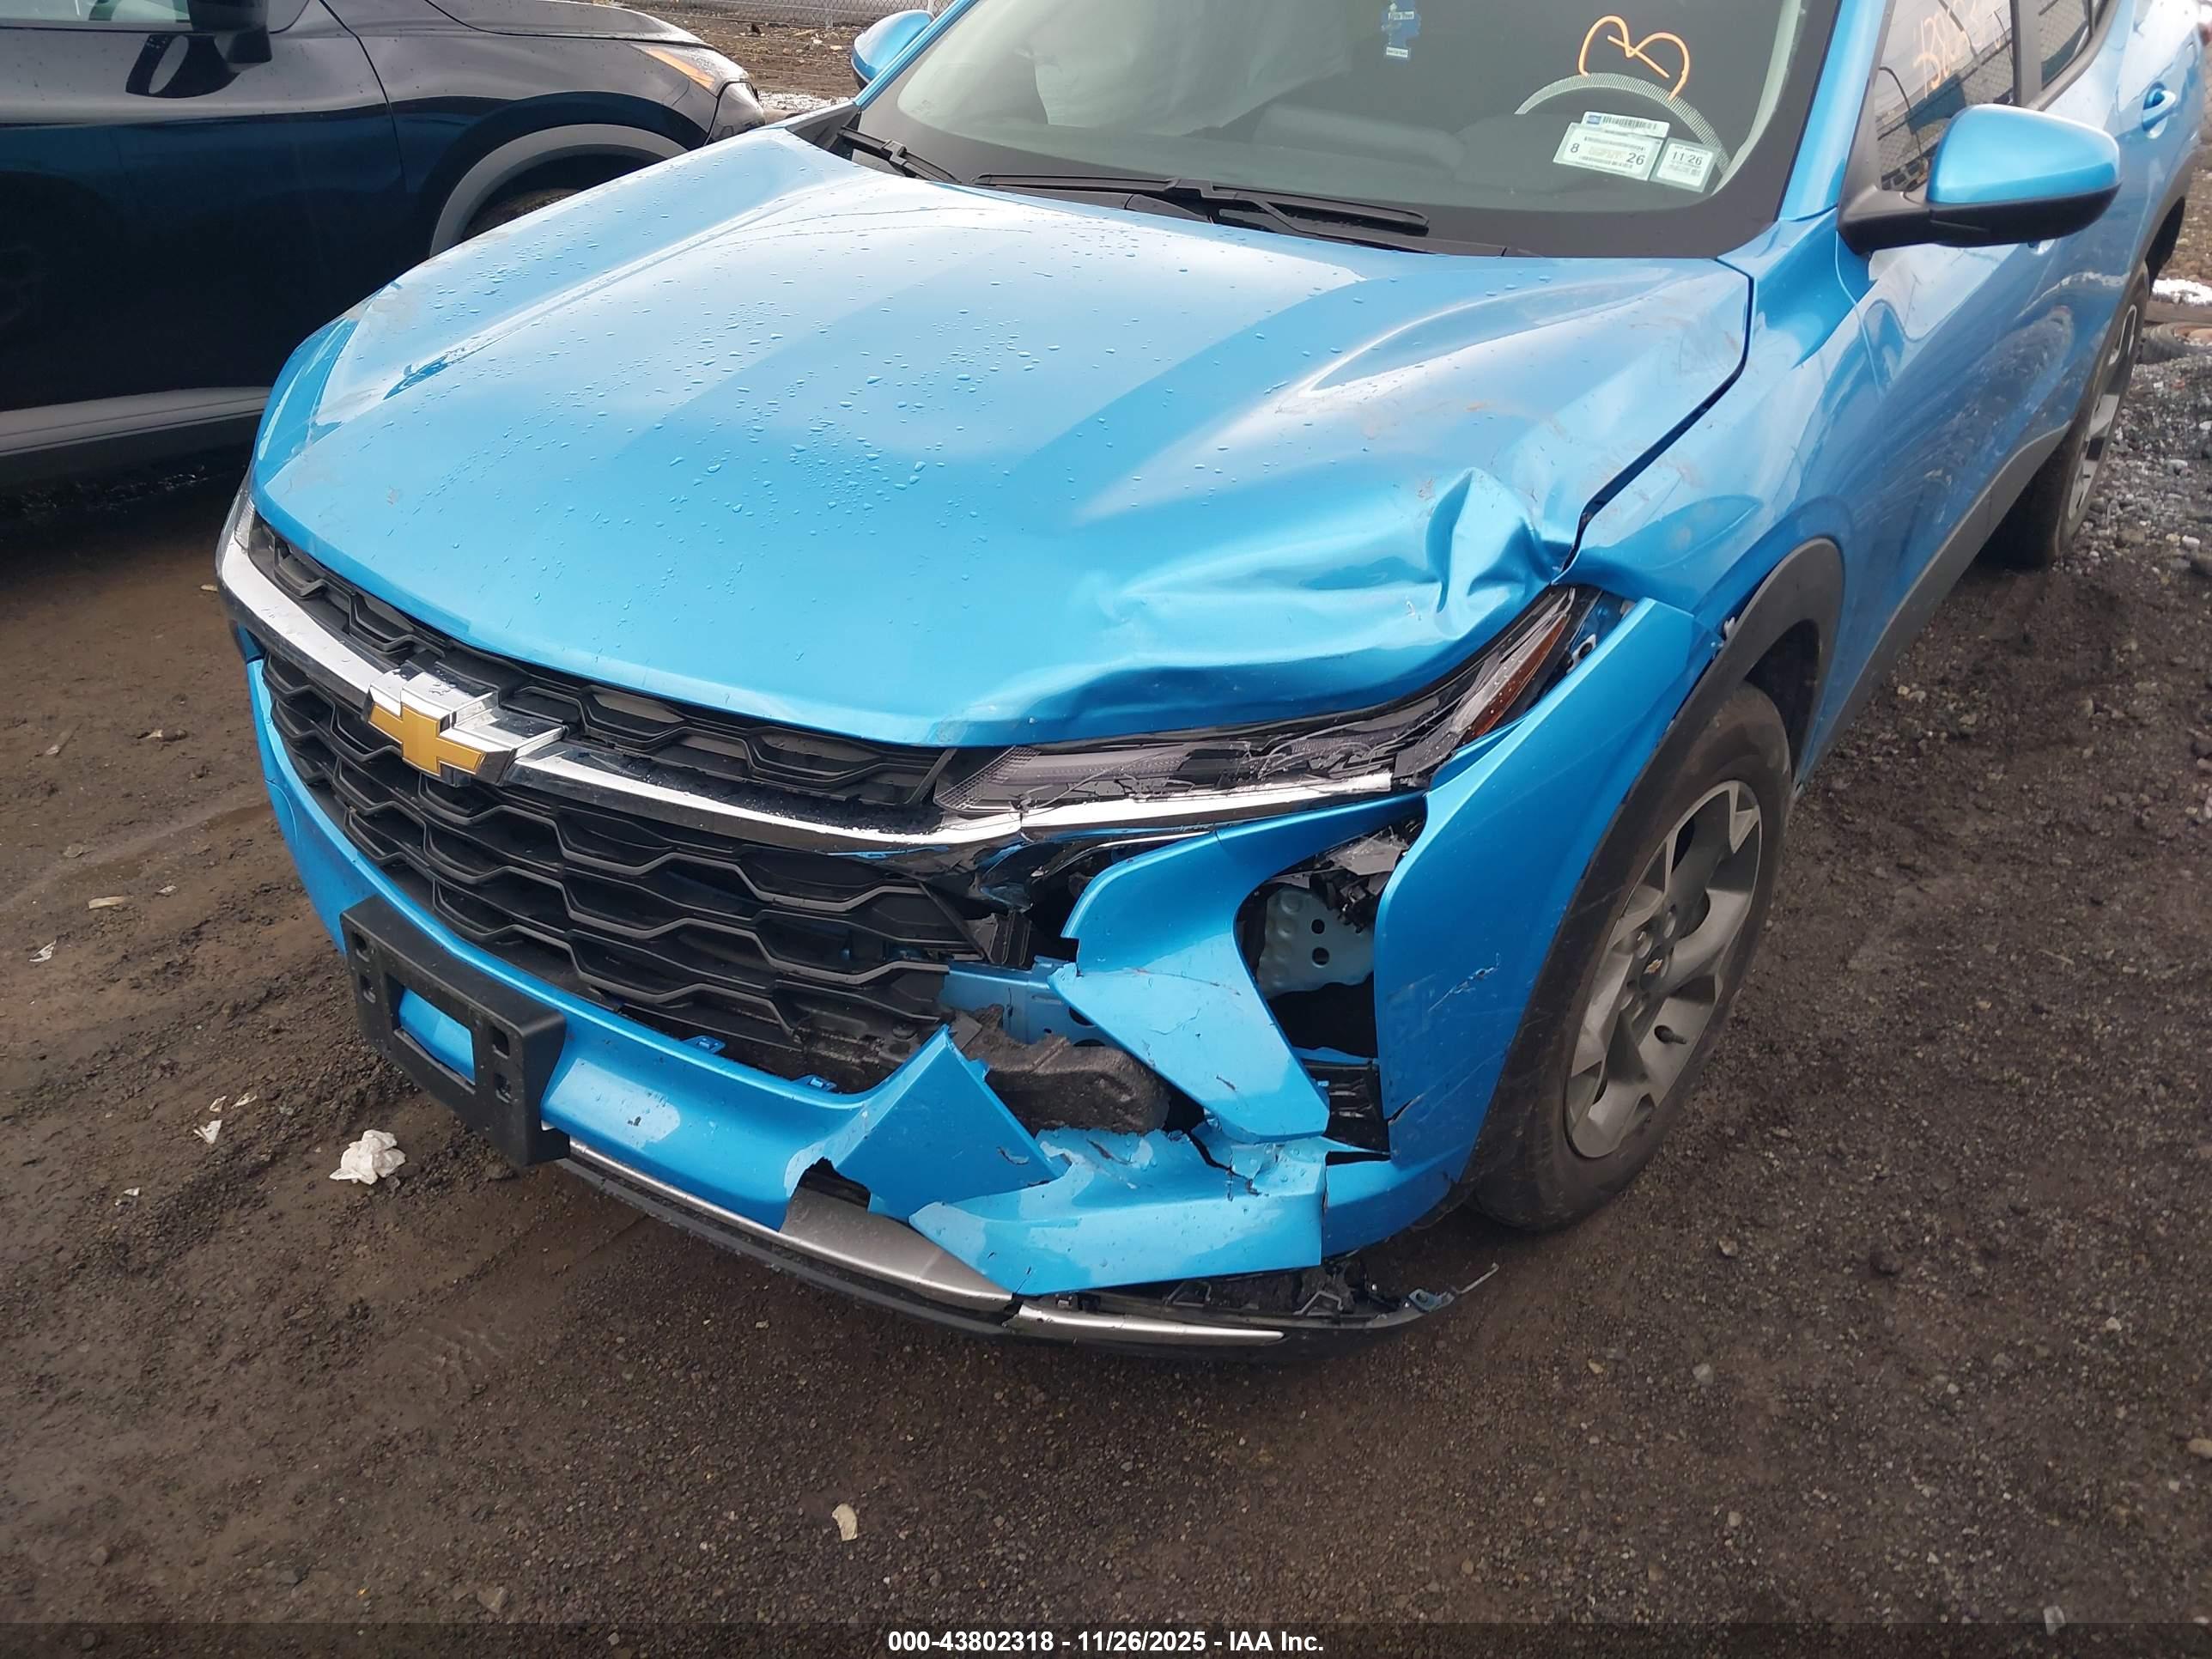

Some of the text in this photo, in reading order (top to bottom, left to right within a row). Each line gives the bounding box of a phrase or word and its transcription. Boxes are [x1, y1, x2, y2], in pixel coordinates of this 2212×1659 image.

[1570, 143, 1580, 154] 8
[1626, 152, 1646, 166] 26
[1687, 154, 1703, 166] 26
